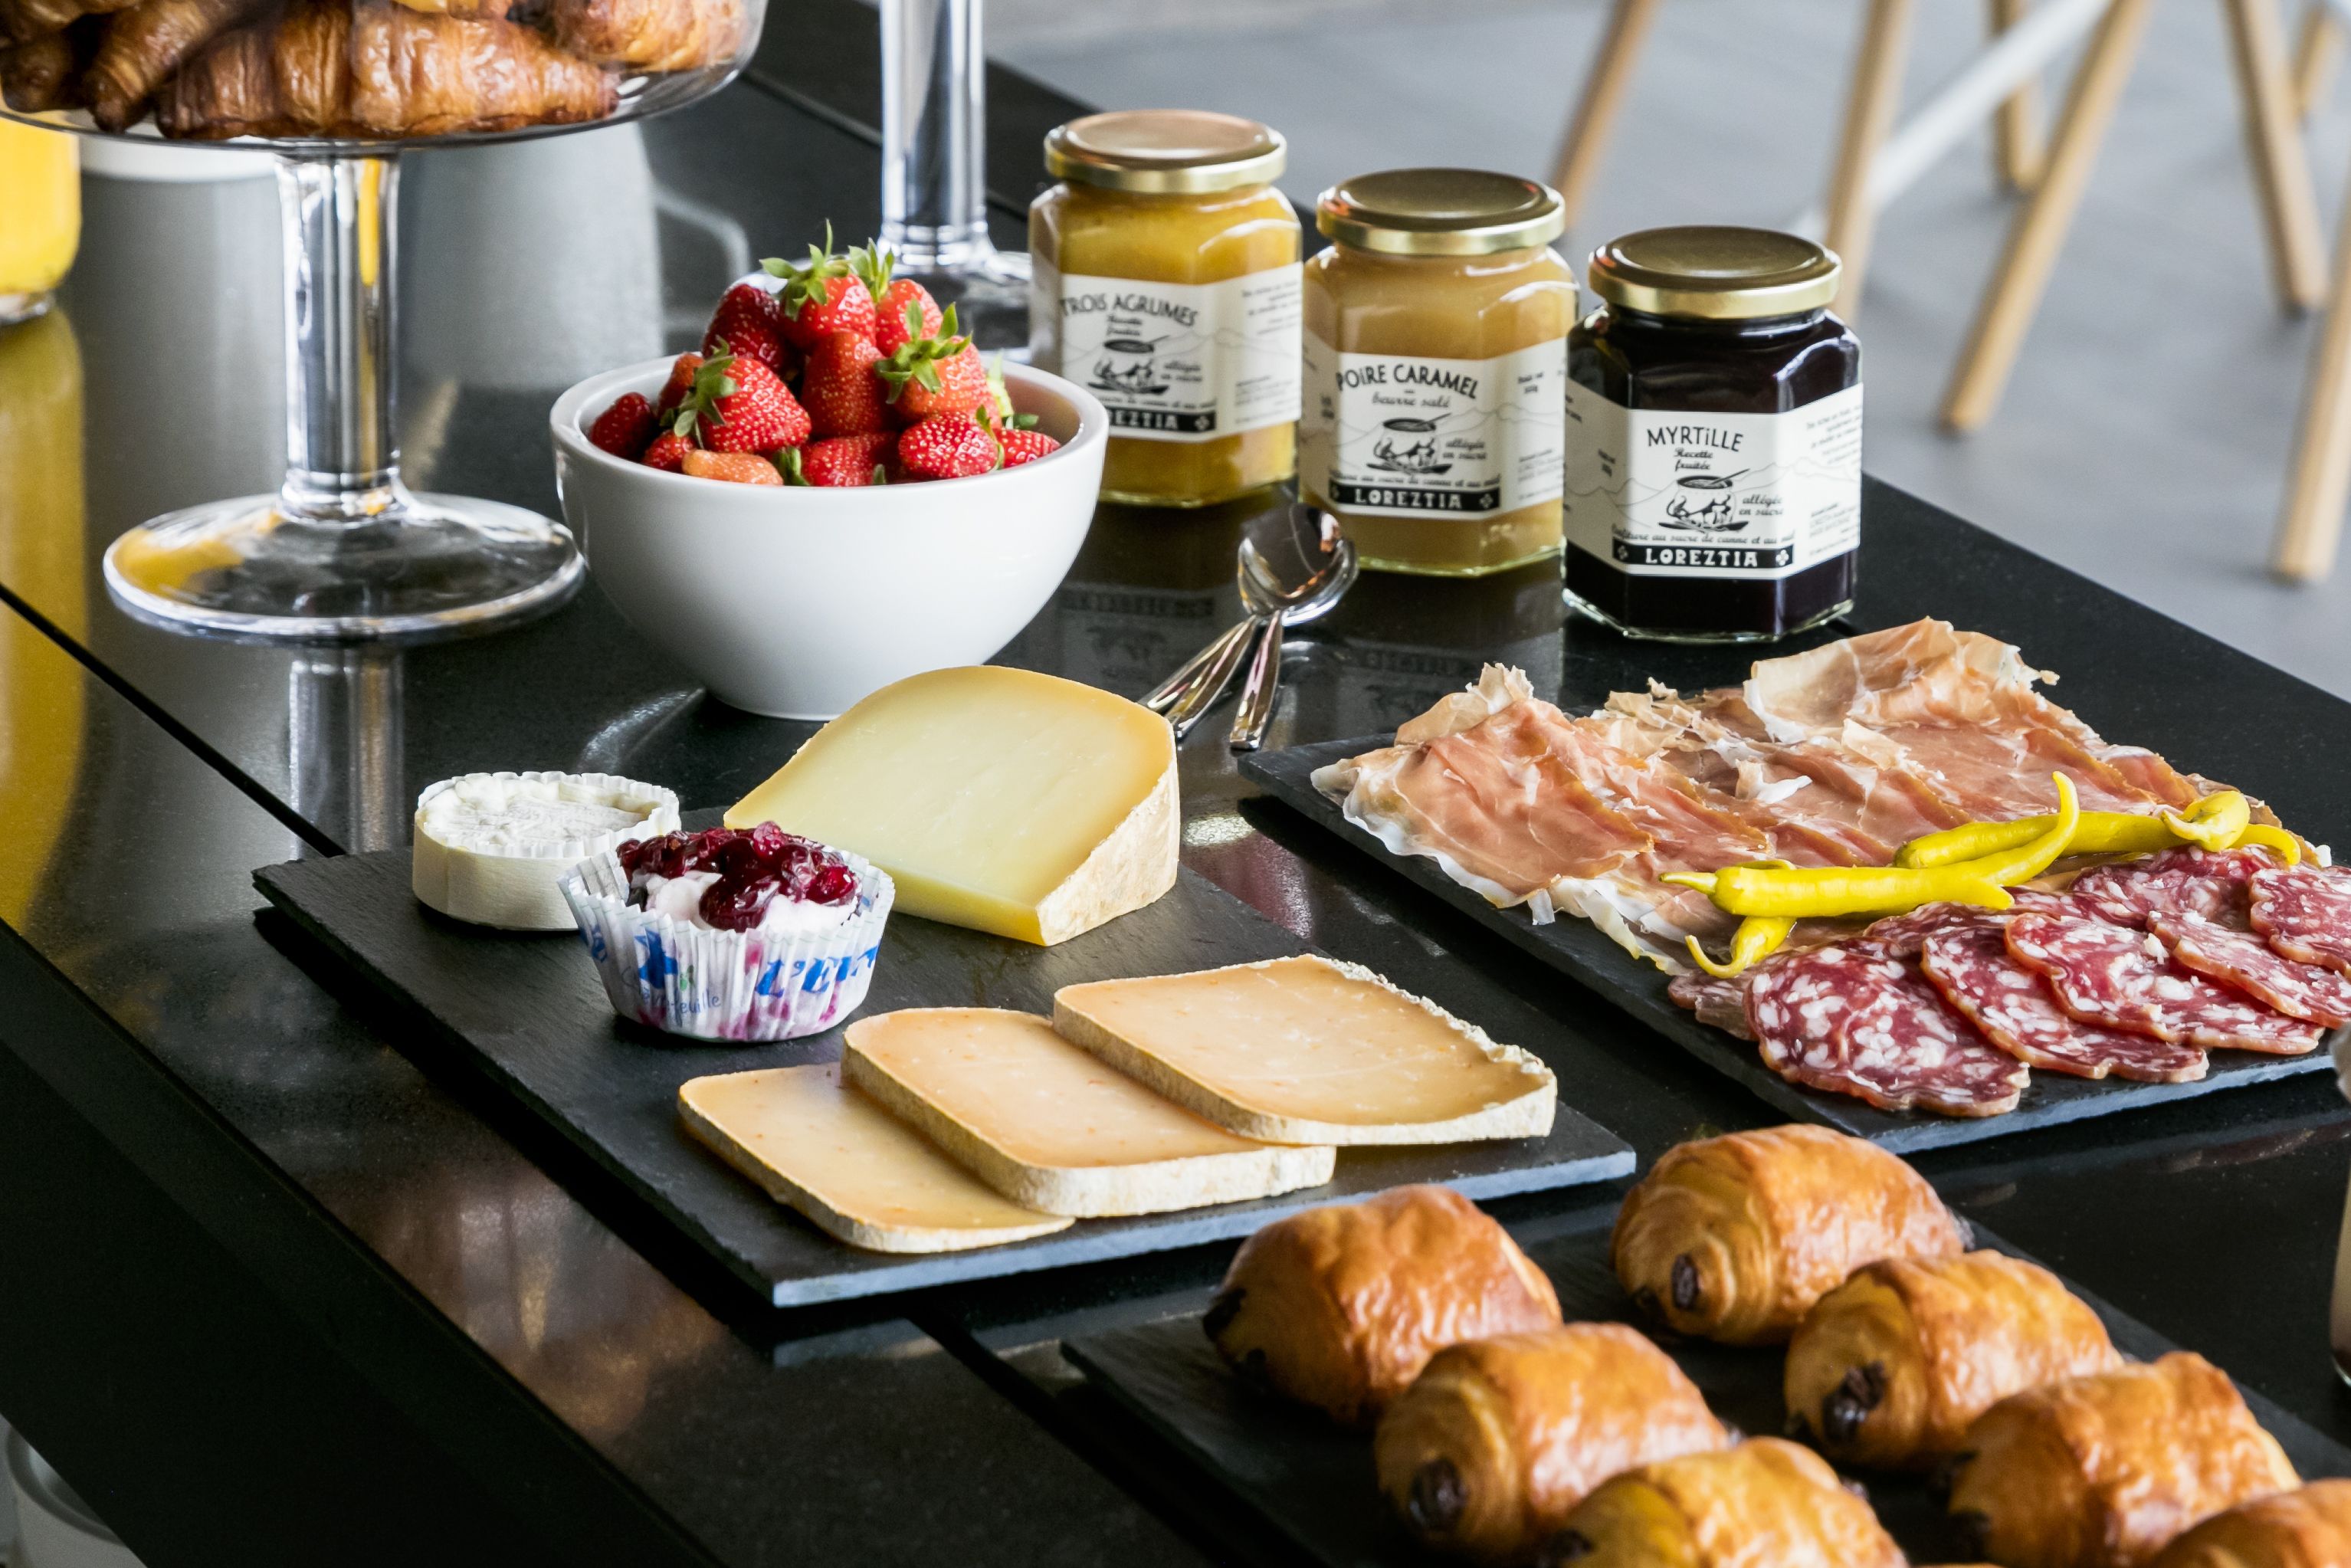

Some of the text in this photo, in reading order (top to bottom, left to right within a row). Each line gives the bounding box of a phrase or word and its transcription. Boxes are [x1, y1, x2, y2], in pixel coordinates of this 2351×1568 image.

[1394, 364, 1478, 399] CARAMEL
[1354, 487, 1462, 510] LOREZTIA
[1646, 548, 1758, 568] LOREZTIA
